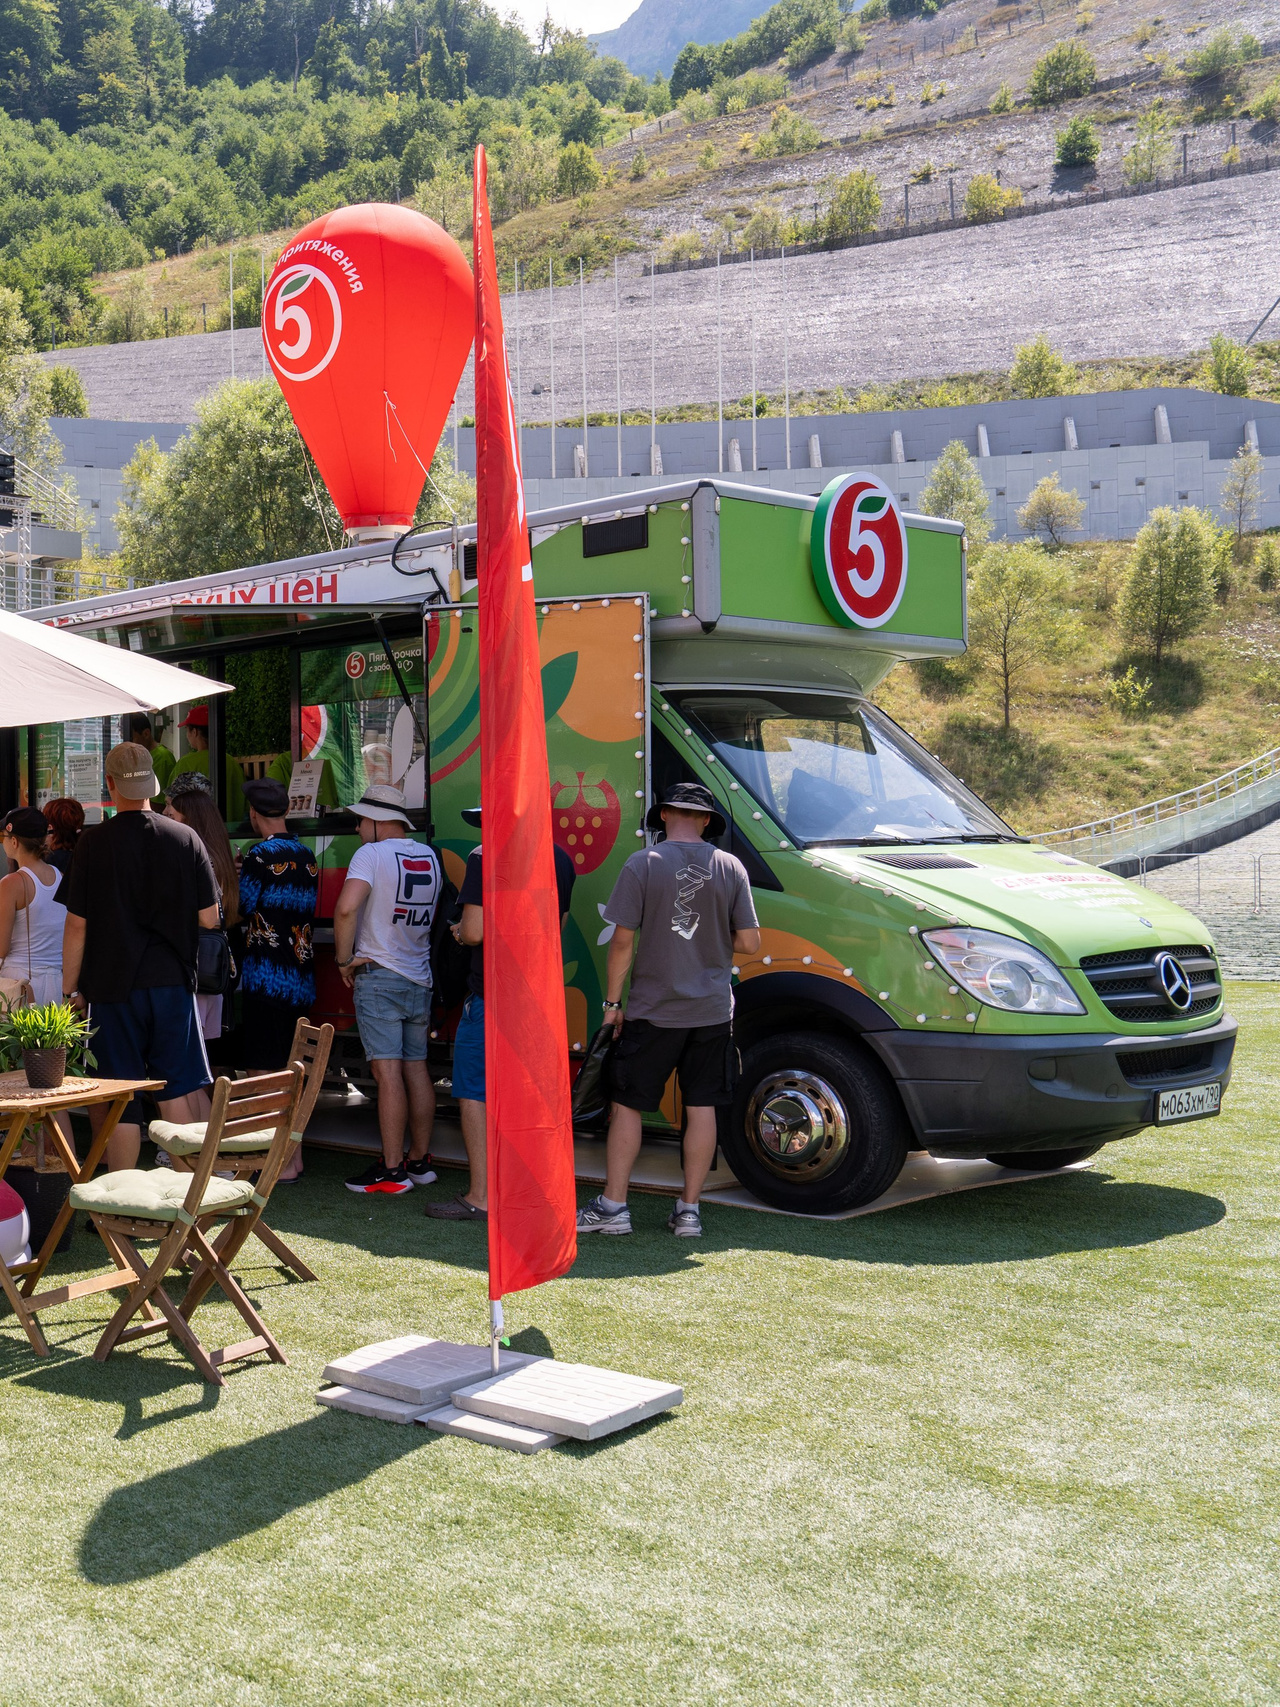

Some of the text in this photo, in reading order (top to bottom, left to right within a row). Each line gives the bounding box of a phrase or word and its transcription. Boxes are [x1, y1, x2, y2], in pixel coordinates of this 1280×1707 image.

[277, 240, 364, 294] притяжения
[369, 648, 422, 663] Пятрочка
[373, 661, 403, 673] забой
[392, 908, 430, 926] FILA
[1205, 1085, 1219, 1104] 790
